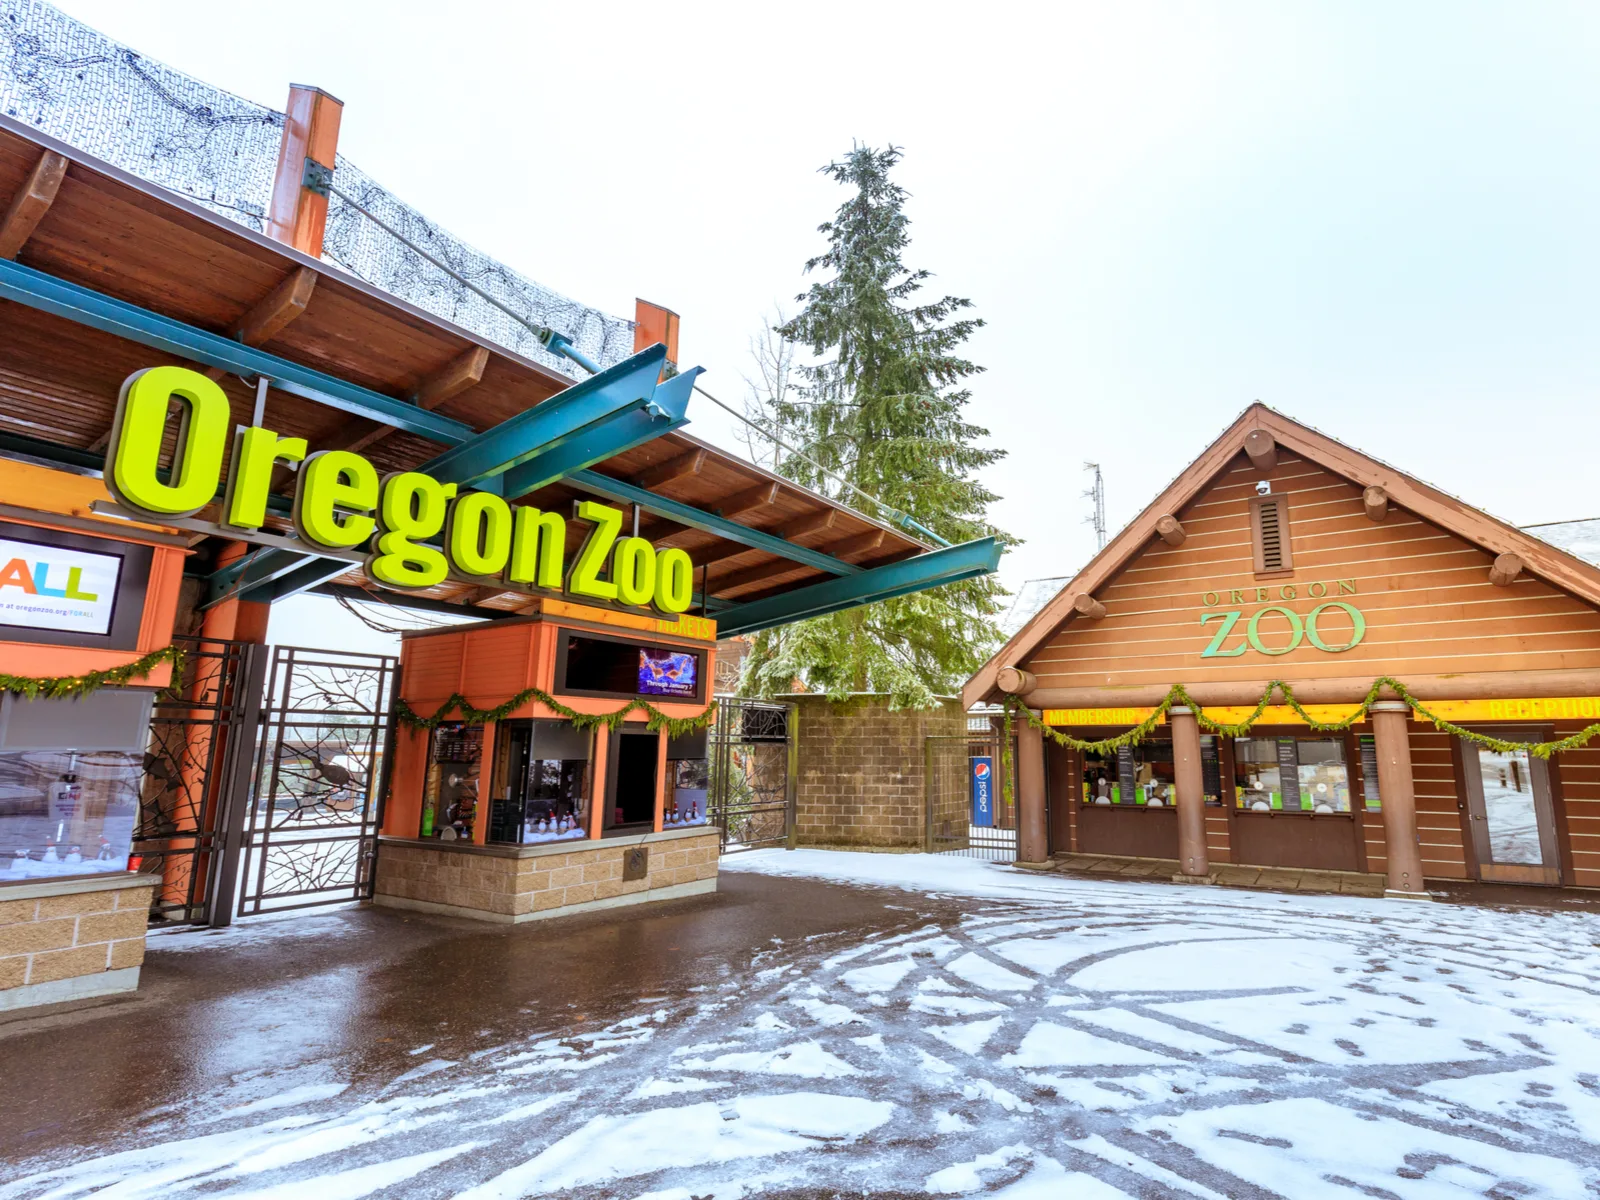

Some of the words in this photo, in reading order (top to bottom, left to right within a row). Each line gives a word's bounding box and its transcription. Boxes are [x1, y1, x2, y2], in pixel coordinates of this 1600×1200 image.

[112, 365, 567, 588] Oregon
[568, 501, 693, 614] Zoo
[0, 558, 99, 602] ALL
[1202, 578, 1357, 607] OREGON
[1200, 601, 1366, 658] ZOO
[646, 680, 668, 689] Through
[1049, 708, 1135, 725] MEMBERSHIP
[978, 781, 988, 812] pepsi
